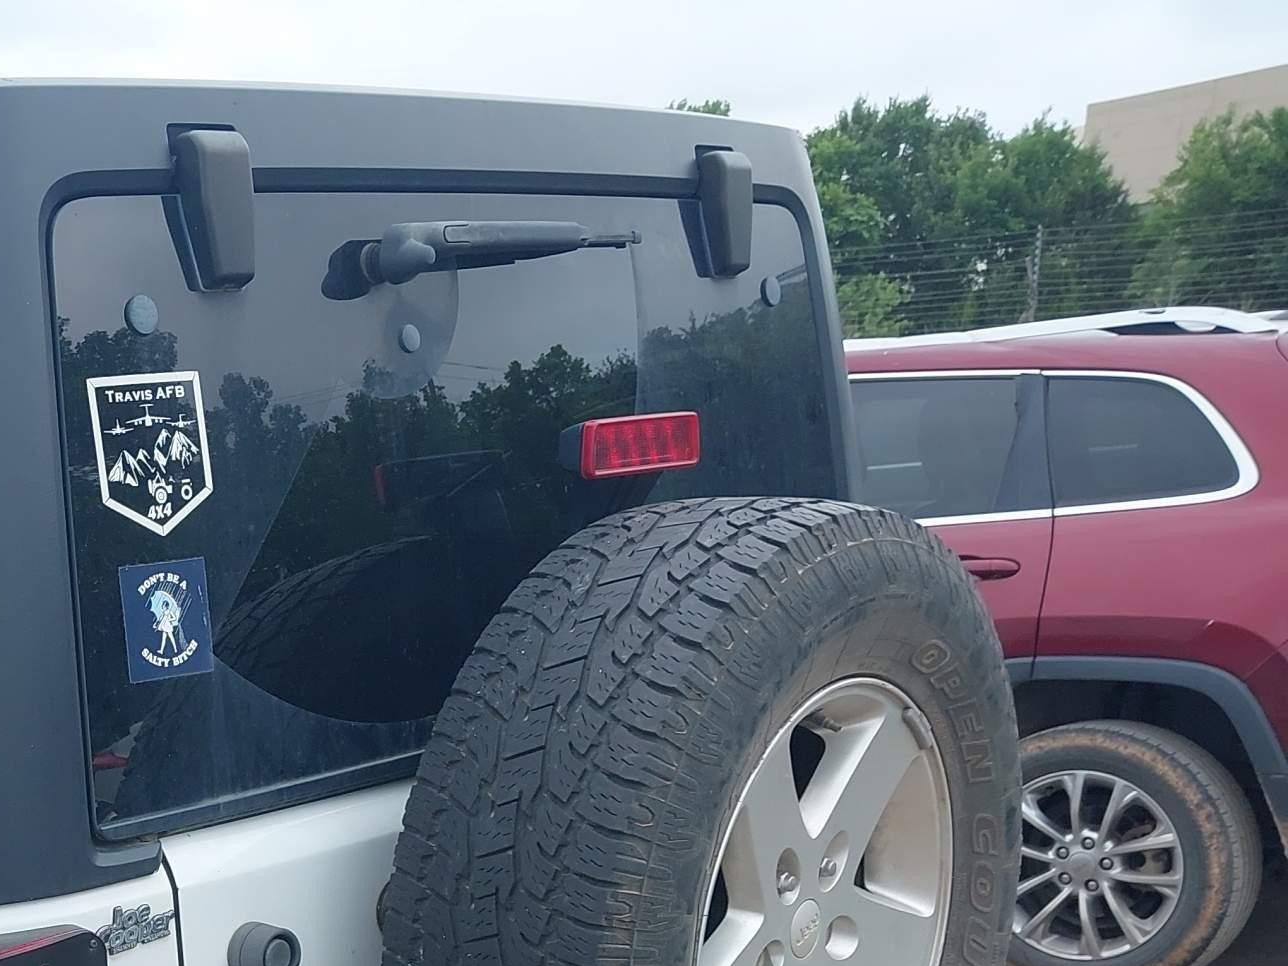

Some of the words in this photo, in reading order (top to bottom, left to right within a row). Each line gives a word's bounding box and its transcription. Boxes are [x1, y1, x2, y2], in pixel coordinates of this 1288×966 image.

[155, 385, 185, 400] AFB
[147, 502, 172, 520] 4X4
[137, 572, 165, 596] DON'T
[166, 572, 180, 585] BE
[179, 580, 188, 590] A
[141, 647, 171, 668] SALTY
[172, 639, 199, 667] BITCH
[910, 638, 993, 785] OPEN
